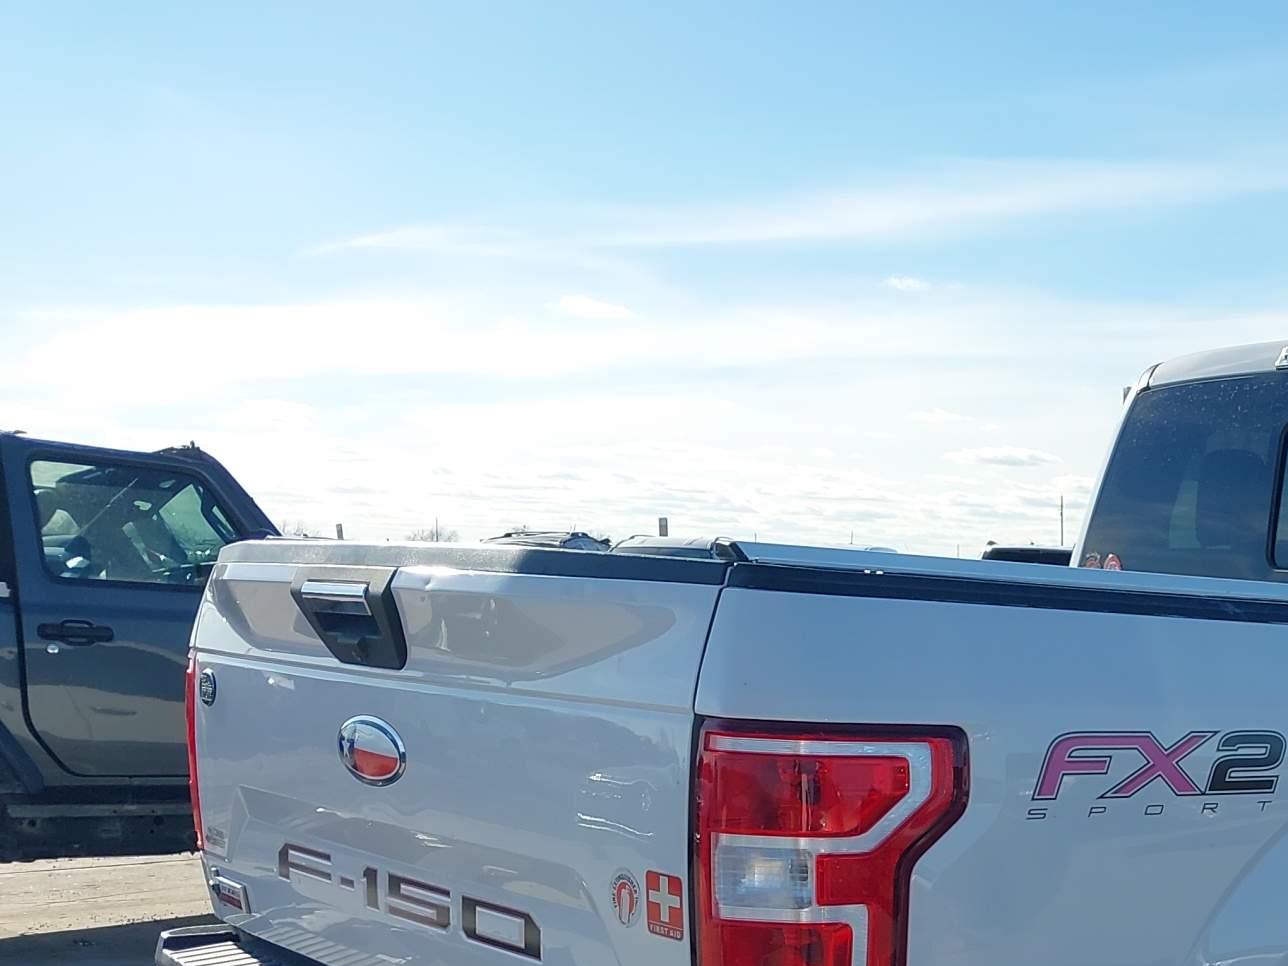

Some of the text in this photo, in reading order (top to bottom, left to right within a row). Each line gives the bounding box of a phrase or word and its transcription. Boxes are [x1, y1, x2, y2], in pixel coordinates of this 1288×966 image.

[1031, 729, 1287, 801] FX2
[1025, 801, 1273, 821] SPORT
[278, 842, 544, 963] F-150
[649, 924, 681, 939] FIRST AID
